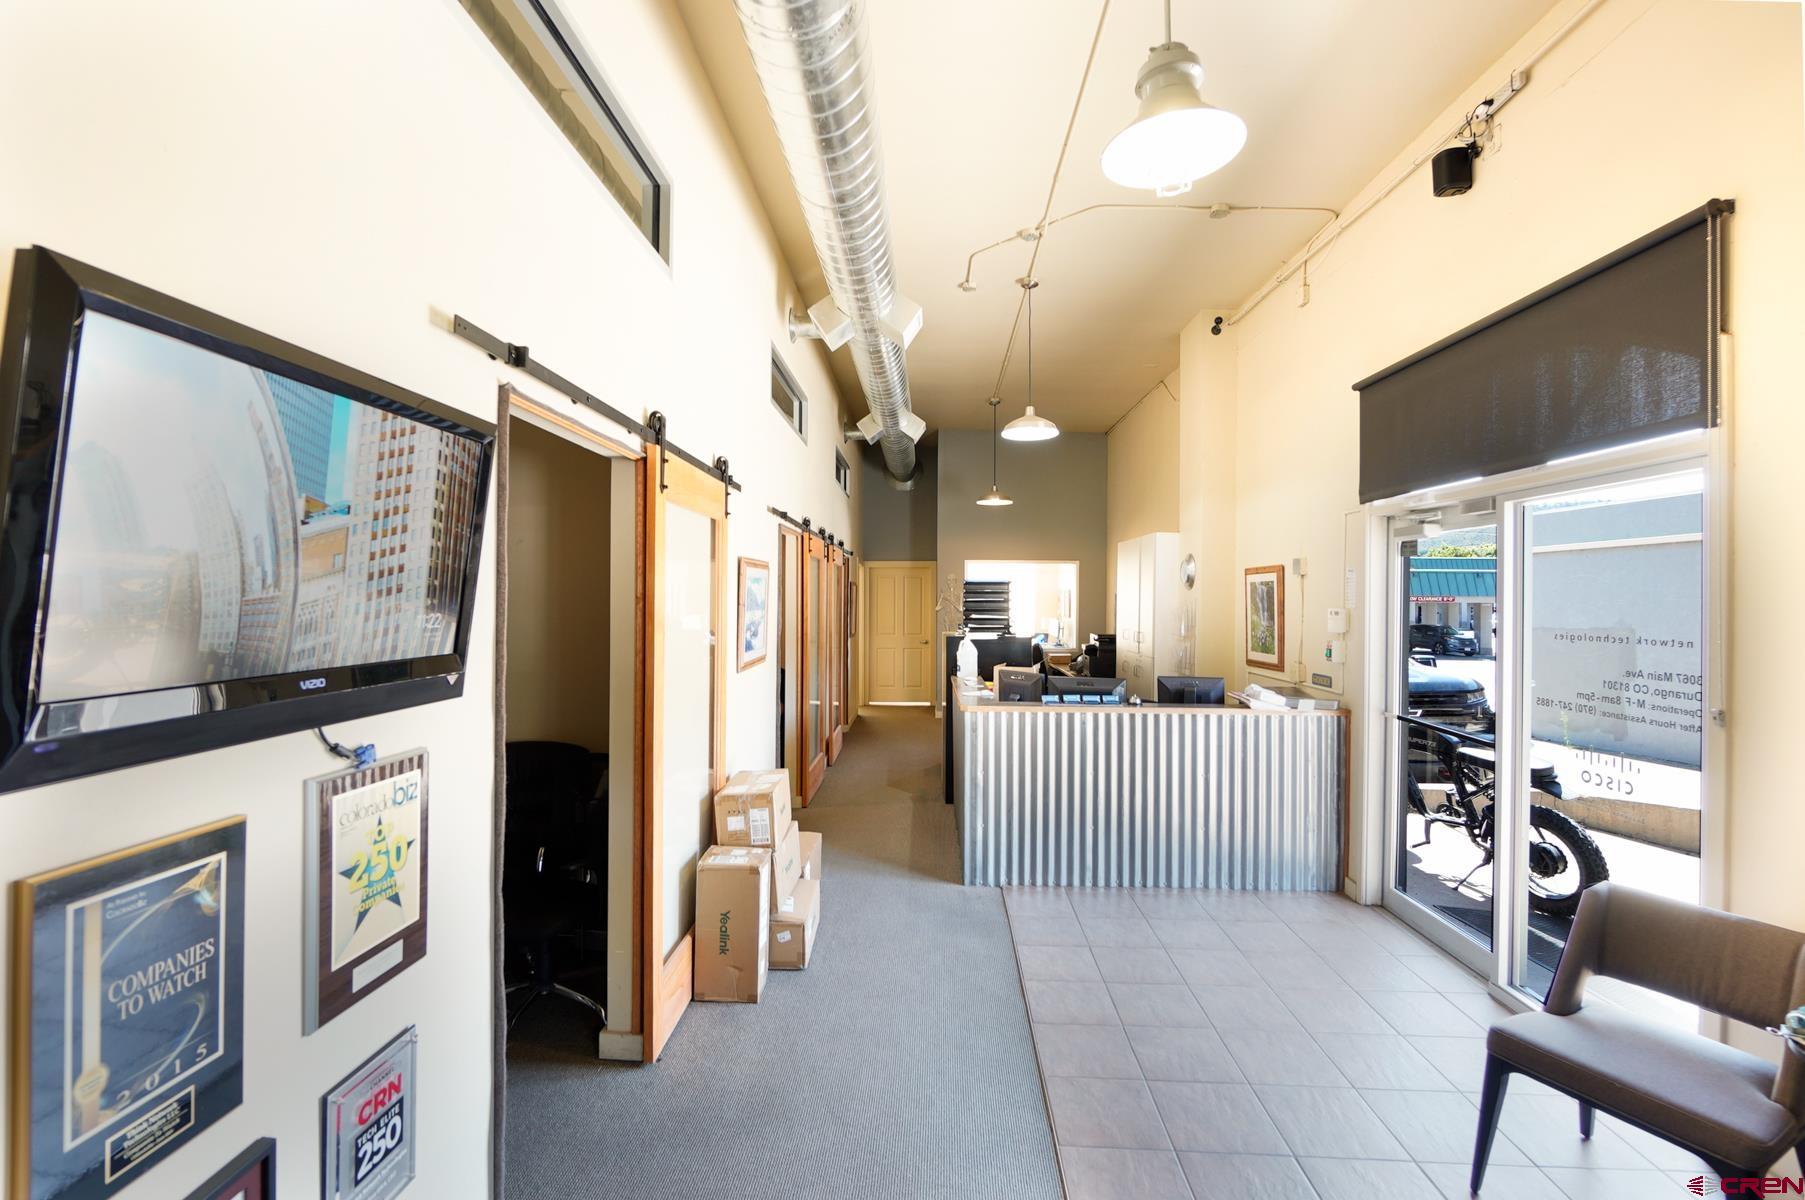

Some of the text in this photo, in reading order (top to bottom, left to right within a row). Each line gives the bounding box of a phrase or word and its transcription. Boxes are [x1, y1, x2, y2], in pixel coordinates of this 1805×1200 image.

[300, 677, 326, 690] VIZIO
[349, 833, 408, 895] 250
[360, 879, 397, 899] Private
[719, 910, 731, 956] Yealink
[108, 937, 215, 1004] COMPANIES
[117, 961, 207, 1021] TO WATCH
[358, 1072, 402, 1125] CRN
[357, 1103, 400, 1148] TECH ELITE
[357, 1114, 402, 1181] 250
